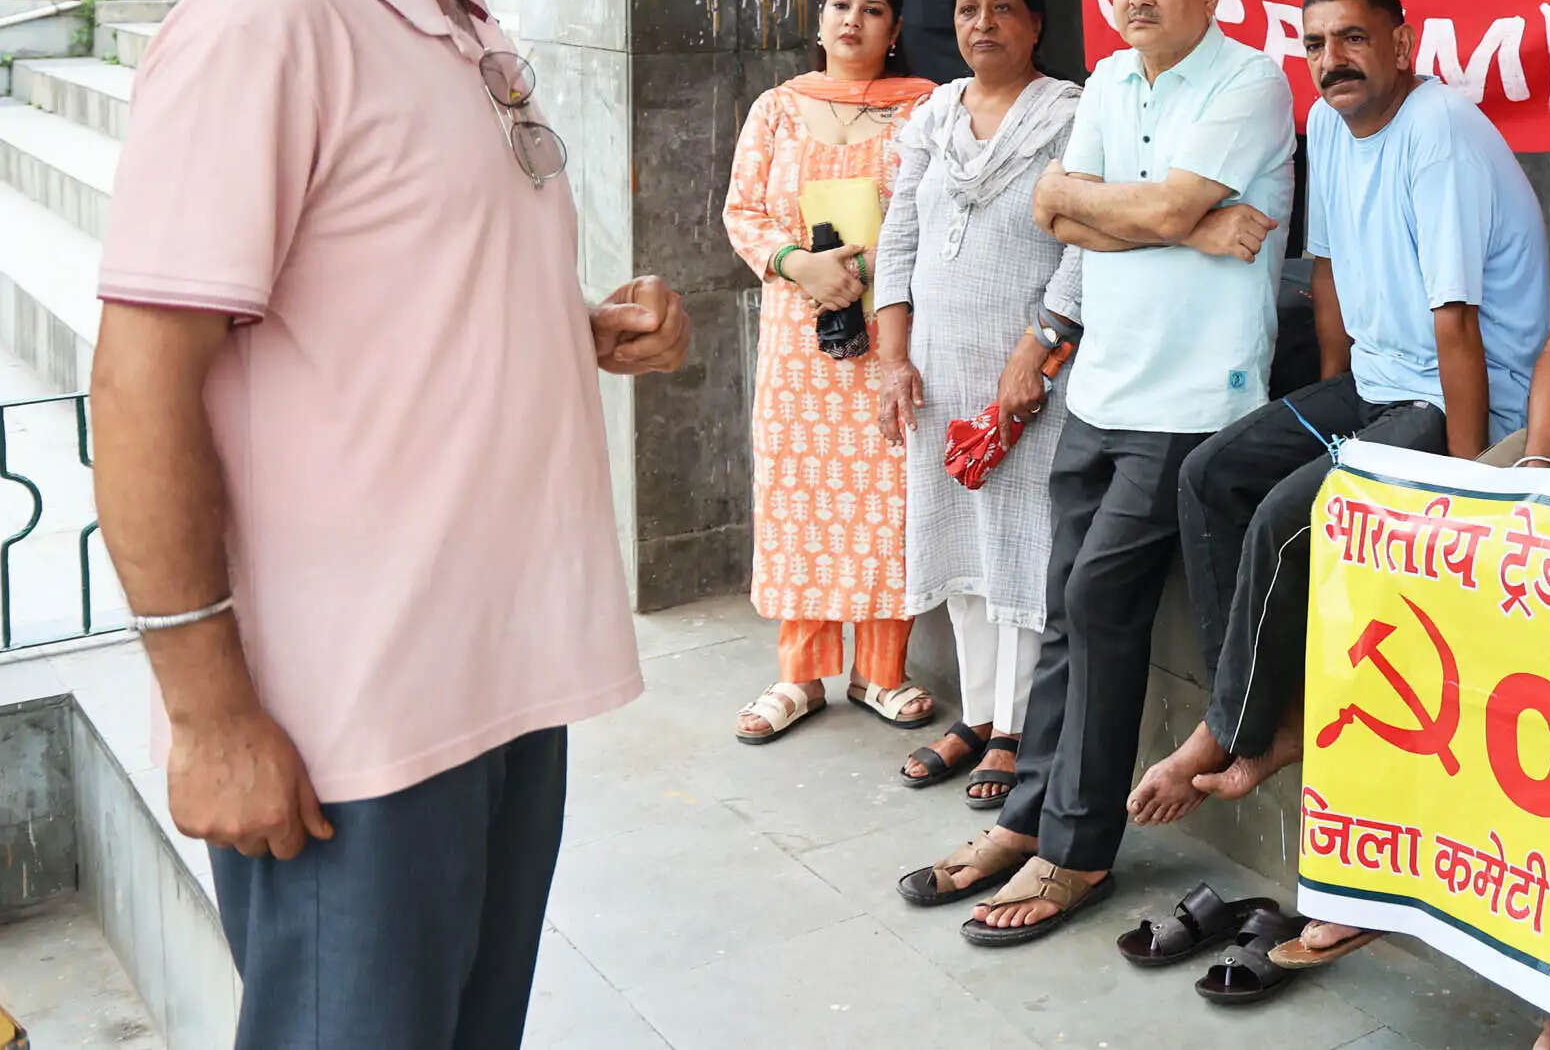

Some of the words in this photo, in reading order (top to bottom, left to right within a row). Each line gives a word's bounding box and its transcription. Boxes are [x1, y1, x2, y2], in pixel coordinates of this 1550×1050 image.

[1325, 497, 1492, 590] भारतीय
[1300, 786, 1423, 877] जिला
[1434, 830, 1550, 933] कमेटी
